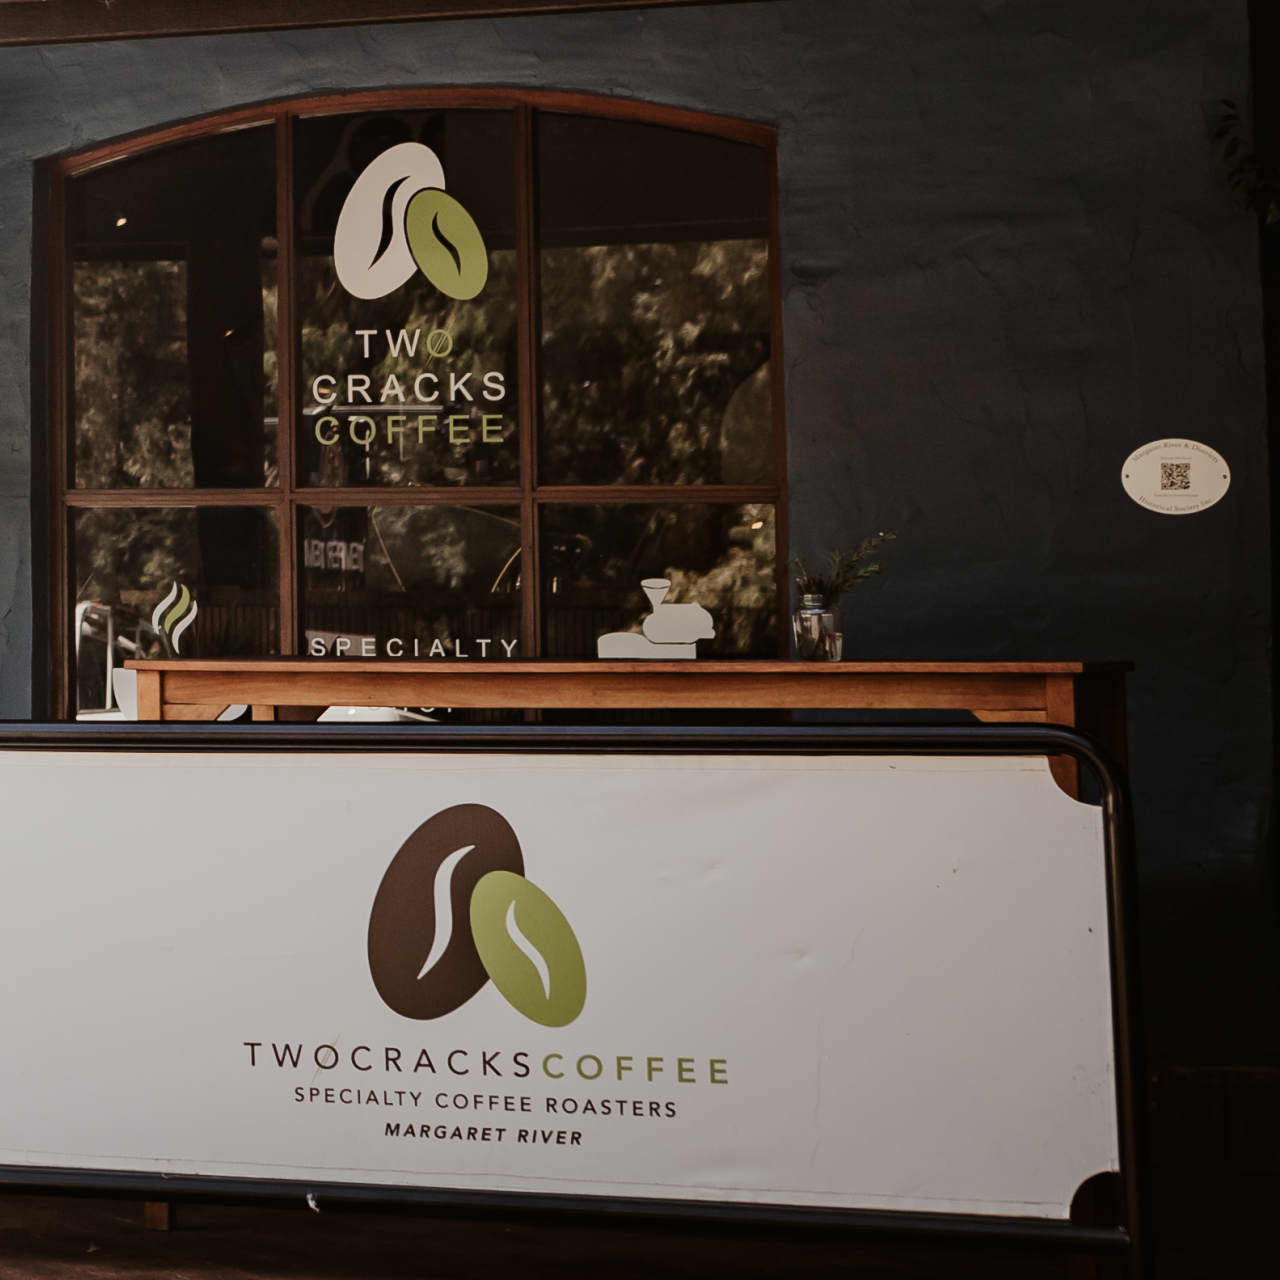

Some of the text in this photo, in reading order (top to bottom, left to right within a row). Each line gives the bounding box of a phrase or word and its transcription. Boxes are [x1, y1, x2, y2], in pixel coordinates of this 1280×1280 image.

[354, 328, 454, 358] TWO
[311, 370, 507, 405] CRACKS
[314, 413, 505, 446] COFFEE
[310, 637, 519, 658] SPECIALTY
[294, 1086, 677, 1119] SPECIALTY COFFEE ROASTERS
[383, 1122, 583, 1146] MARGARET RIVER
